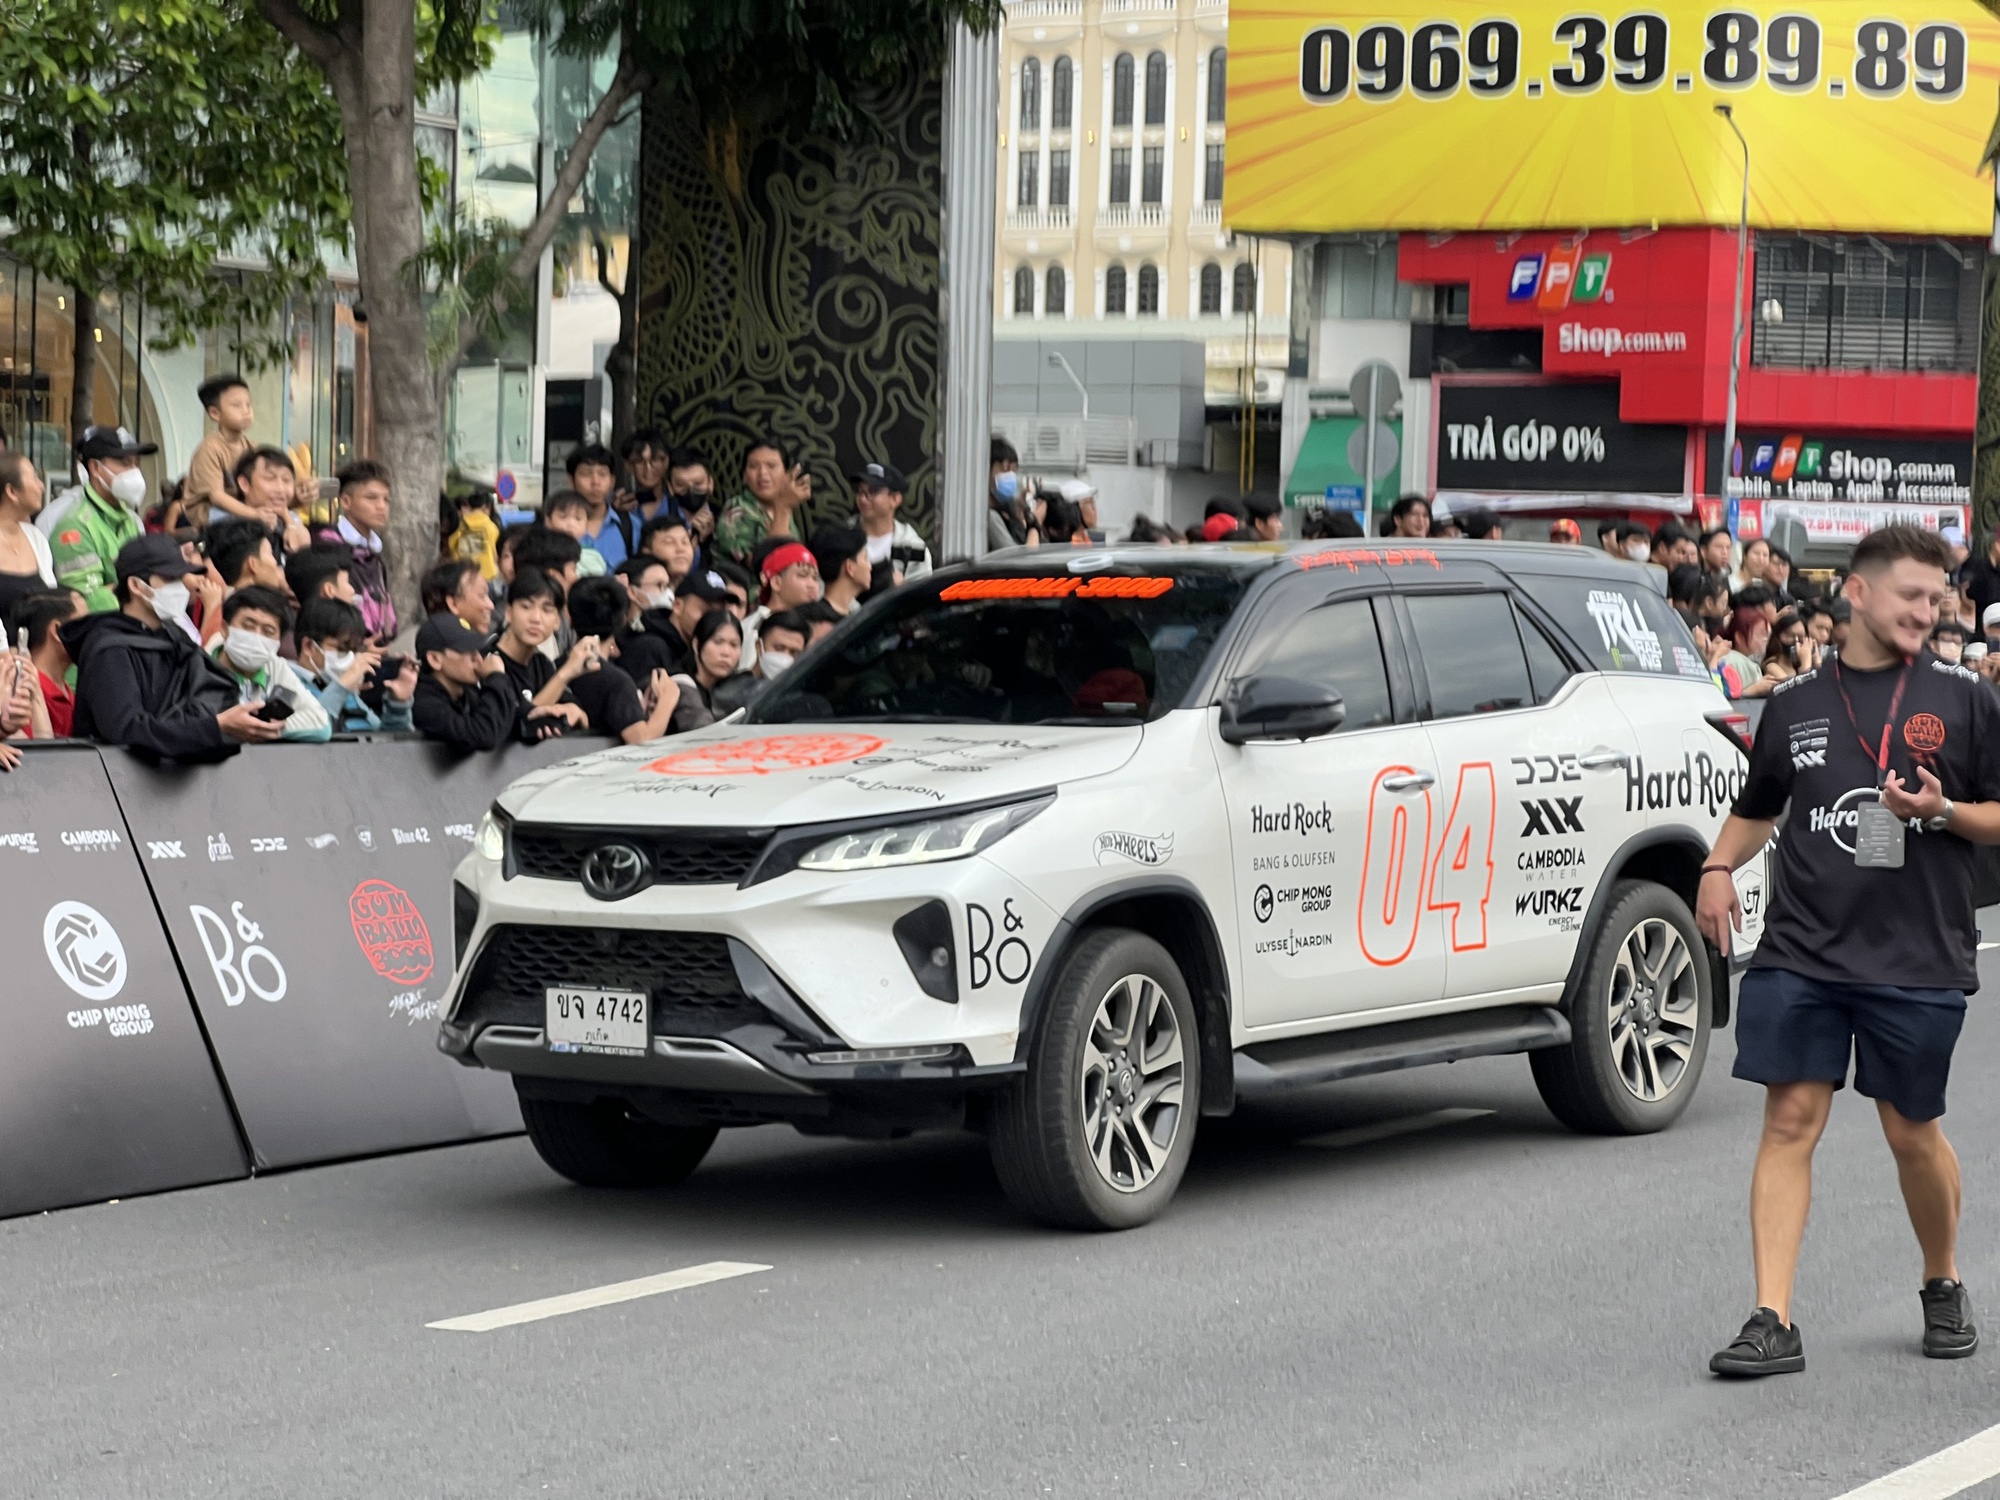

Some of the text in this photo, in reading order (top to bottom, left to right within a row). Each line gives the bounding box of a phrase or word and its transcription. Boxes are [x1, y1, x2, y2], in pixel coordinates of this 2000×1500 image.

[1302, 12, 1967, 102] 0969.39.89.89
[1559, 322, 1687, 357] Shop.com.vn
[1447, 415, 1605, 462] TRẢ GÓP 0%
[1829, 449, 1956, 483] Shop.com.vn
[1788, 477, 1834, 501] Laptop
[1846, 479, 1885, 502] Apple
[1897, 482, 1971, 504] Accessories
[1622, 750, 1691, 812] Hard
[1251, 800, 1333, 837] Hard Rock
[1519, 795, 1585, 837] XIX
[61, 829, 122, 846] CAMBODIA
[1253, 851, 1336, 871] BANG & OLUFSEN
[1358, 761, 1496, 967] 04
[1517, 847, 1586, 870] CAMBODIA
[1526, 869, 1577, 882] WATER
[351, 892, 412, 919] GUM
[1277, 885, 1332, 903] CHIP MONG
[1301, 900, 1331, 913] GROUP
[1515, 887, 1585, 917] WURKZ
[356, 915, 427, 946] BALL
[1549, 916, 1575, 926] ENERGY
[1561, 923, 1582, 932] DRINK
[1255, 934, 1332, 953] ULYSSE NARDIN
[67, 1003, 151, 1028] CHIP MONG
[597, 996, 643, 1023] 4742
[109, 1018, 154, 1037] GROUP
